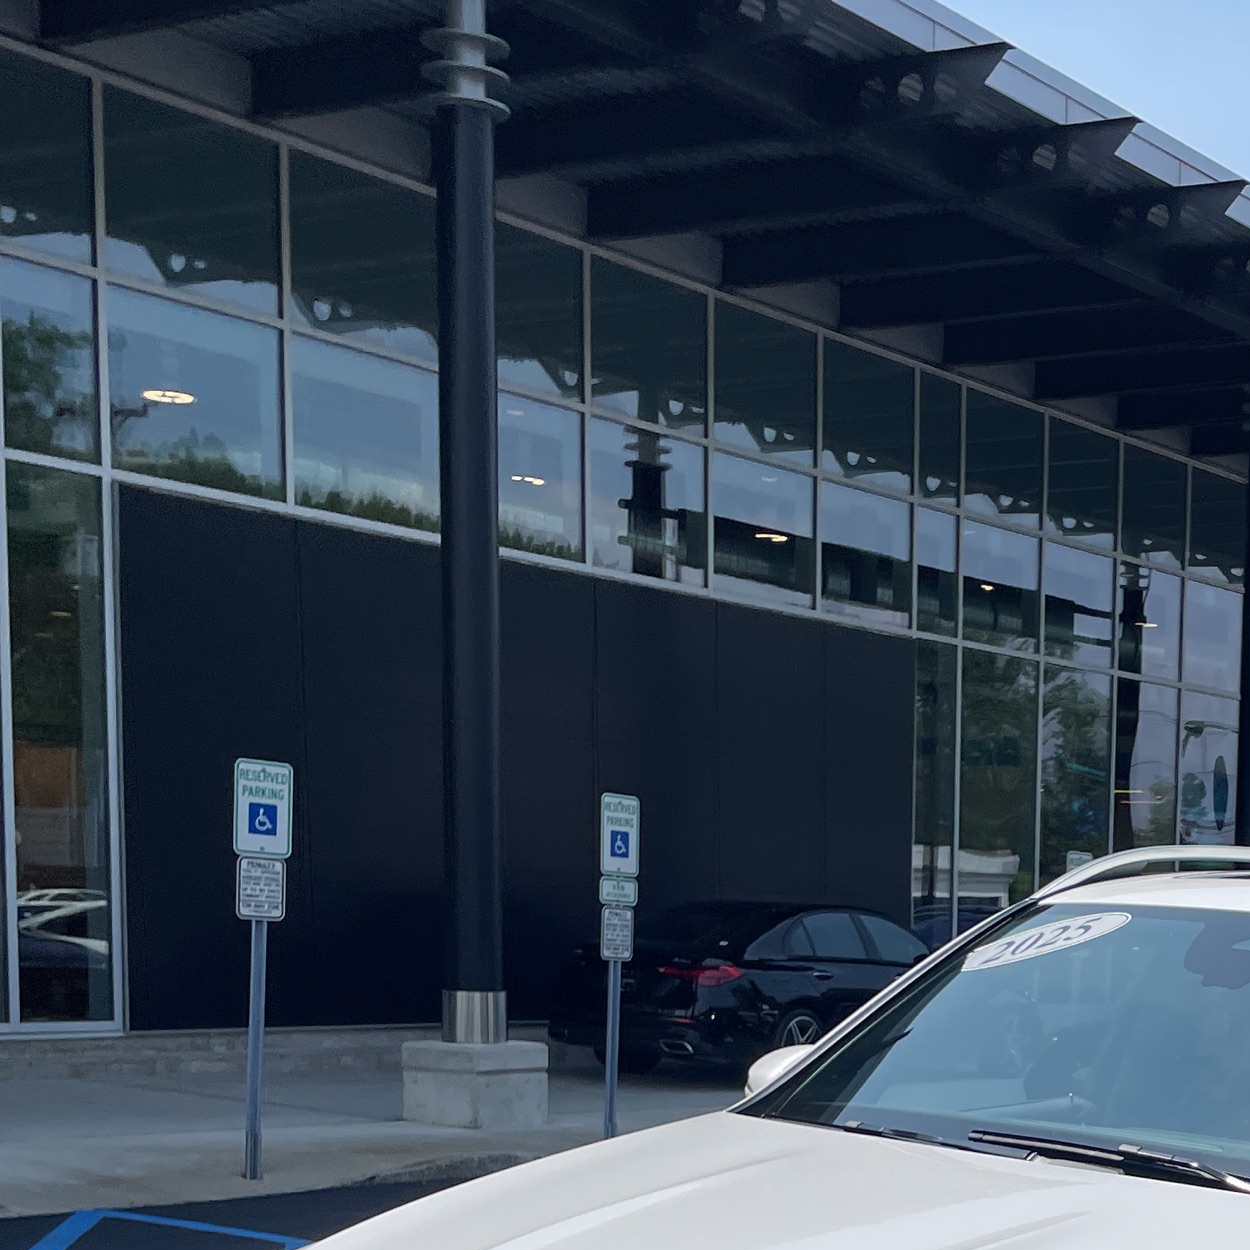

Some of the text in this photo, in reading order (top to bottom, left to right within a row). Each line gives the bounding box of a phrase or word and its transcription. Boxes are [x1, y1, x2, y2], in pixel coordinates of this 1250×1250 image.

[240, 768, 288, 786] RESERVED
[242, 785, 285, 801] PARKING
[604, 801, 637, 816] RESERVED
[606, 815, 635, 829] PARKING
[978, 916, 1103, 966] 2025
